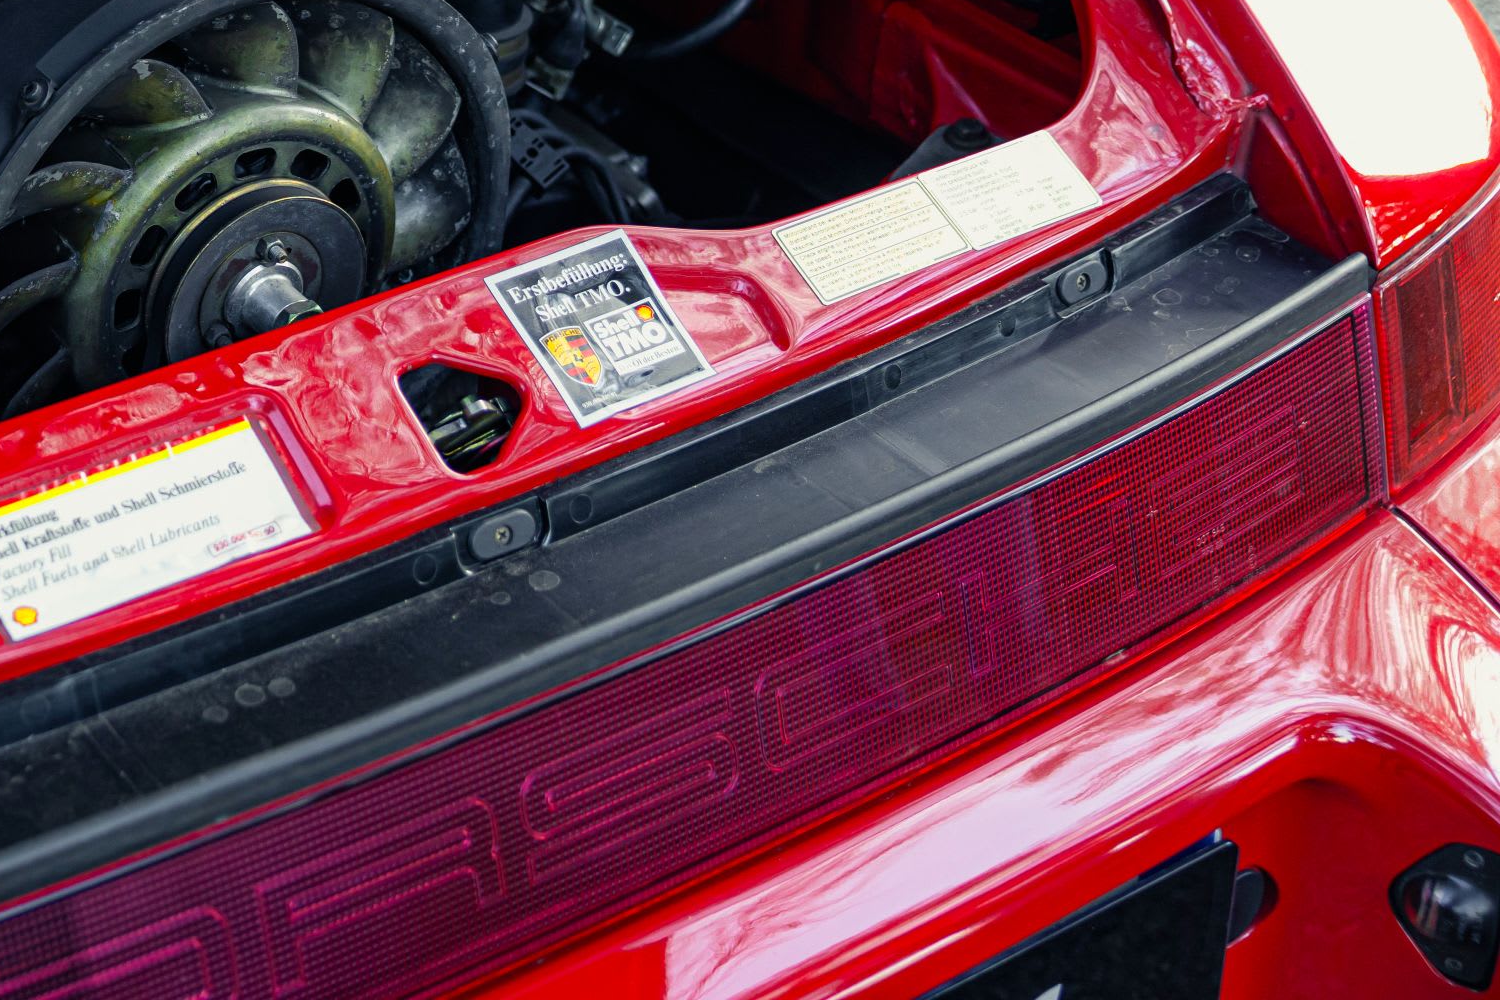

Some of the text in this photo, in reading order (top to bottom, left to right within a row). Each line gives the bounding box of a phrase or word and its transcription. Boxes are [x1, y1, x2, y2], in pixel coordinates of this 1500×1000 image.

[506, 253, 629, 305] Erstbefüllung:
[535, 278, 632, 323] Shell TMO.
[592, 310, 641, 340] Shell
[601, 321, 668, 361] TMO
[22, 517, 91, 551] Kraftstoffe
[94, 504, 120, 525] und
[121, 490, 157, 514] Shell
[160, 460, 247, 501] Schmierstoffe
[1, 580, 38, 603] Shell
[42, 563, 81, 588] Fuels
[83, 550, 109, 575] and
[111, 536, 147, 562] Shell
[150, 512, 221, 549] Lubricants
[49, 544, 73, 568] Fill
